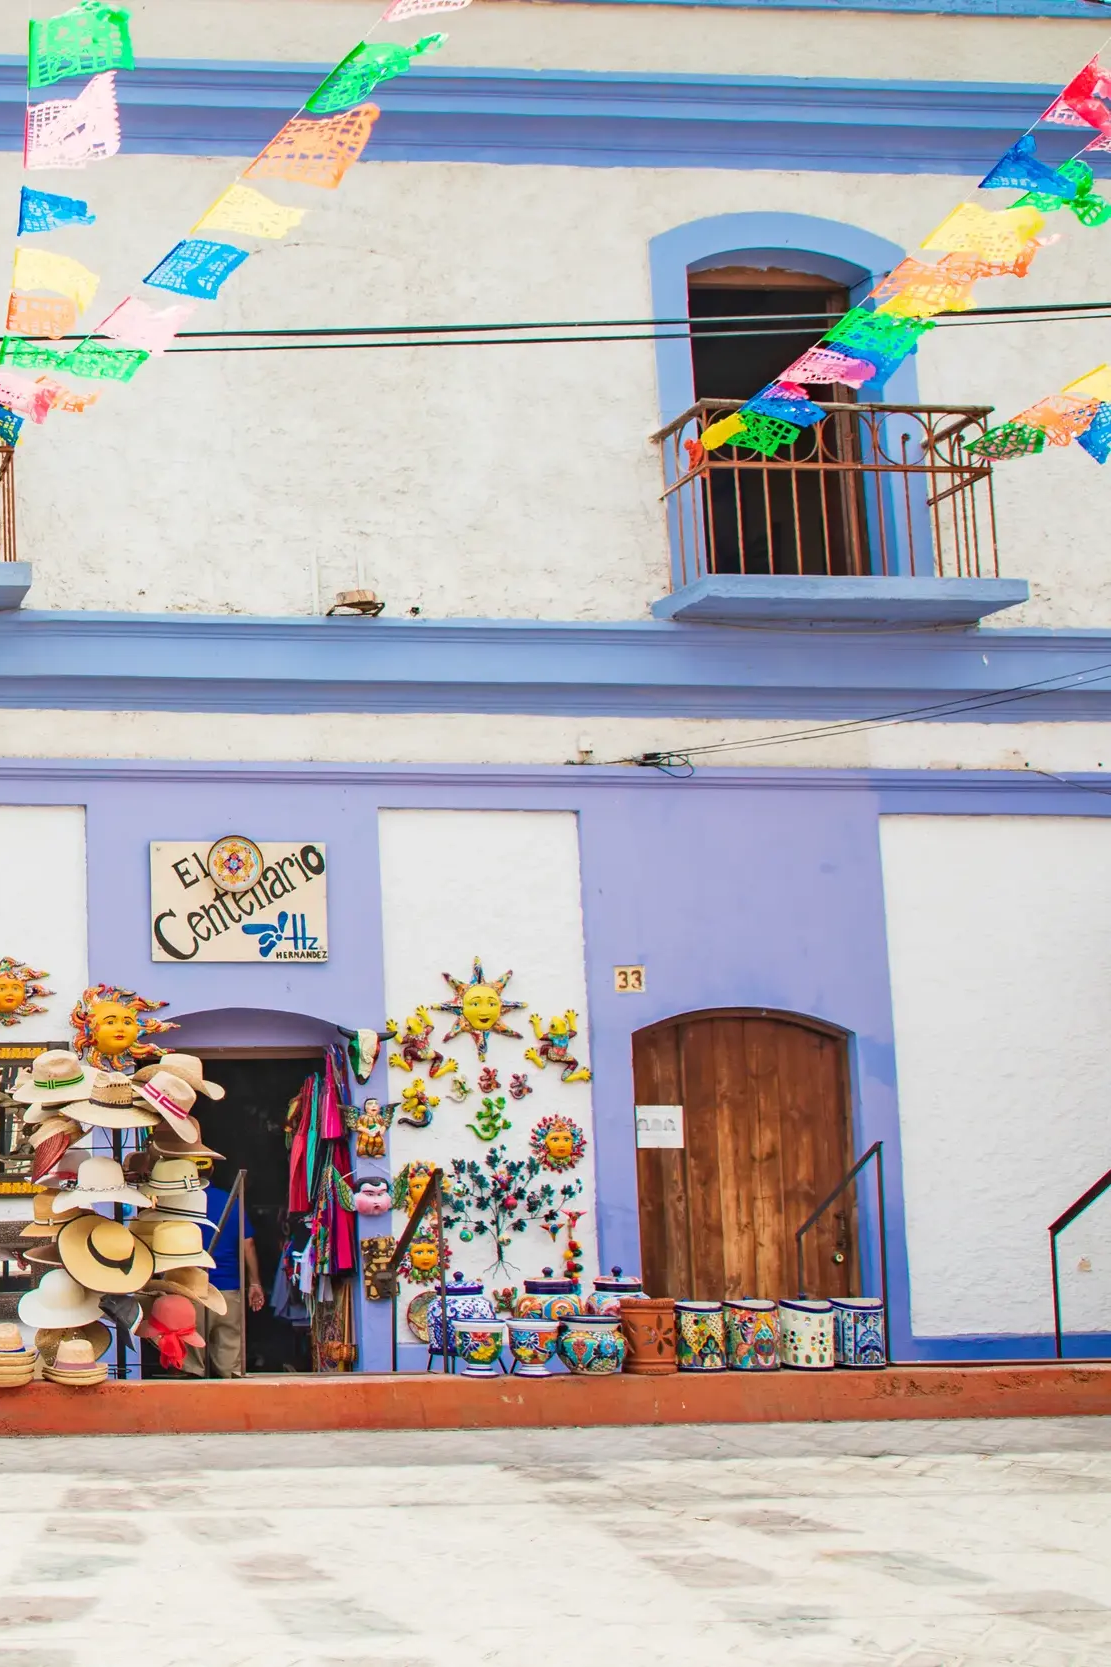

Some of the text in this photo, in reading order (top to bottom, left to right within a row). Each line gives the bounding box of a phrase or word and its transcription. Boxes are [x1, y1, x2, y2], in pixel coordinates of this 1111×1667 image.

[171, 852, 210, 889] El
[276, 951, 328, 959] HERNANDEZ
[617, 970, 642, 989] 33
